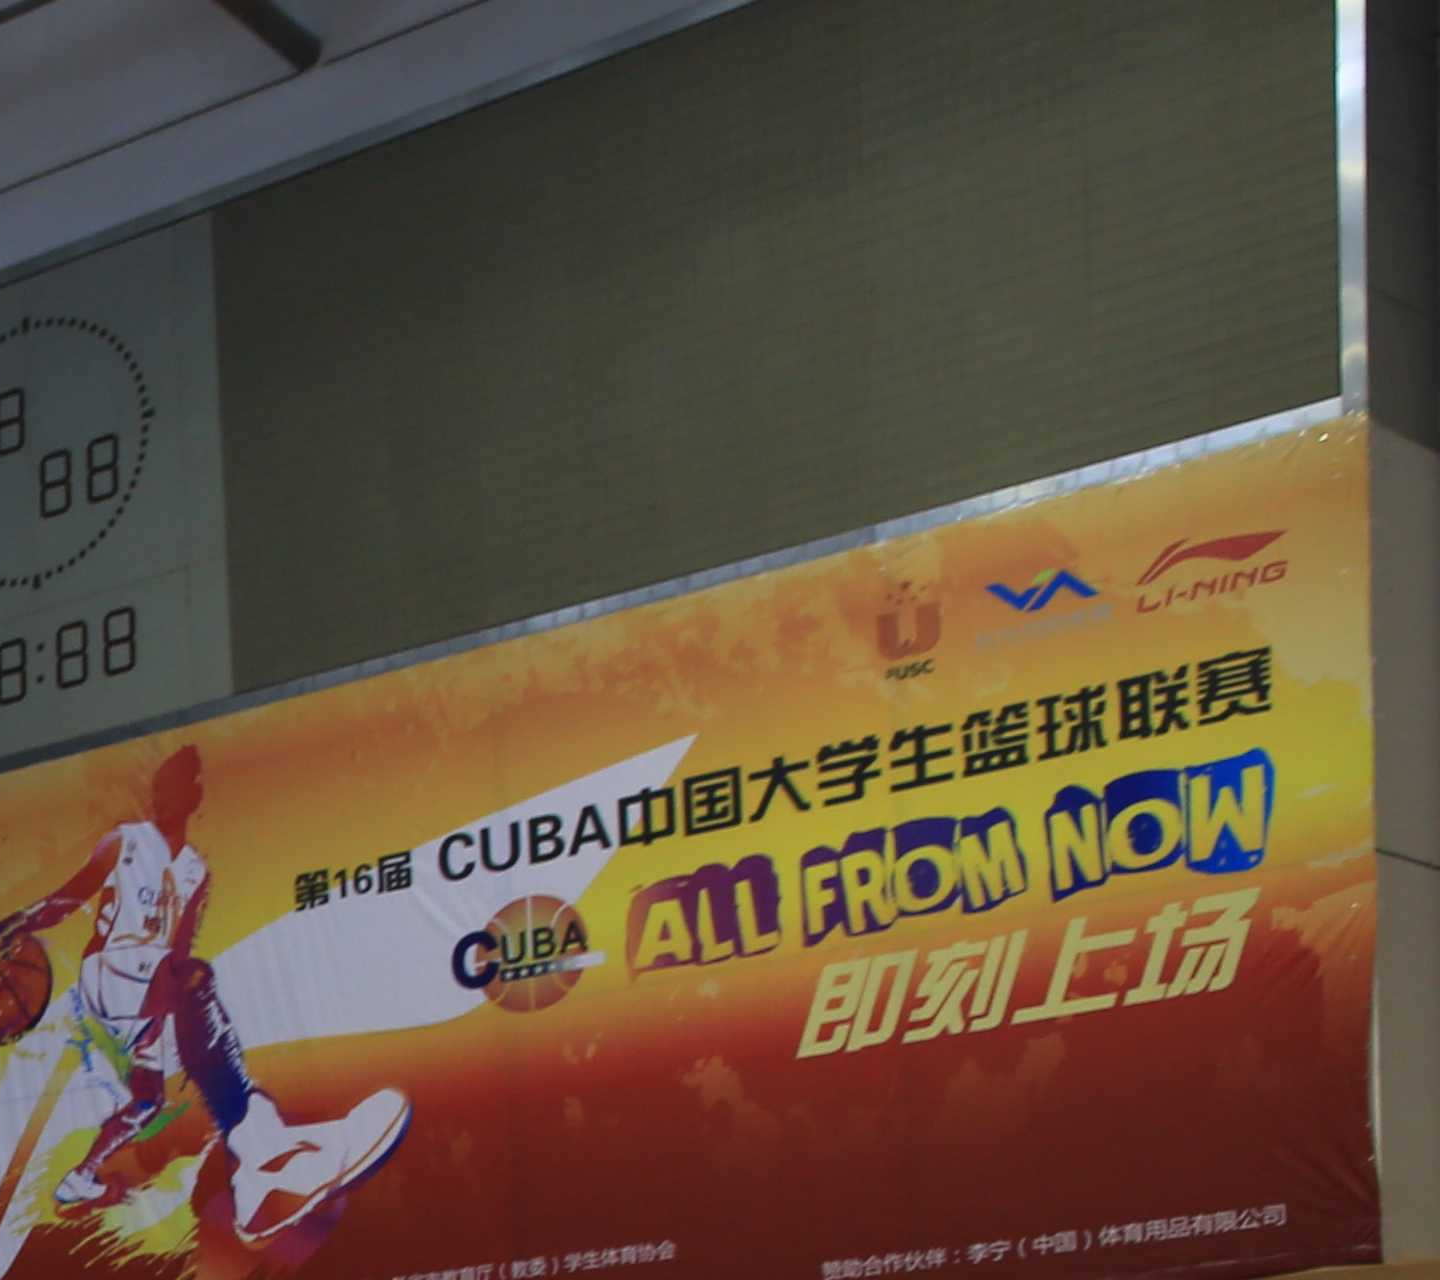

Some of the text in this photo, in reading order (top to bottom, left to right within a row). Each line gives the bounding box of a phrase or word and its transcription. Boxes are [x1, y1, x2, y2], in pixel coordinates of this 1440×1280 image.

[1136, 560, 1288, 613] LI-NING
[294, 849, 412, 913] 第16届
[632, 758, 1270, 975] ALL FROM NOW
[451, 920, 589, 990] CUBA
[795, 887, 1262, 1060] 即刻上场
